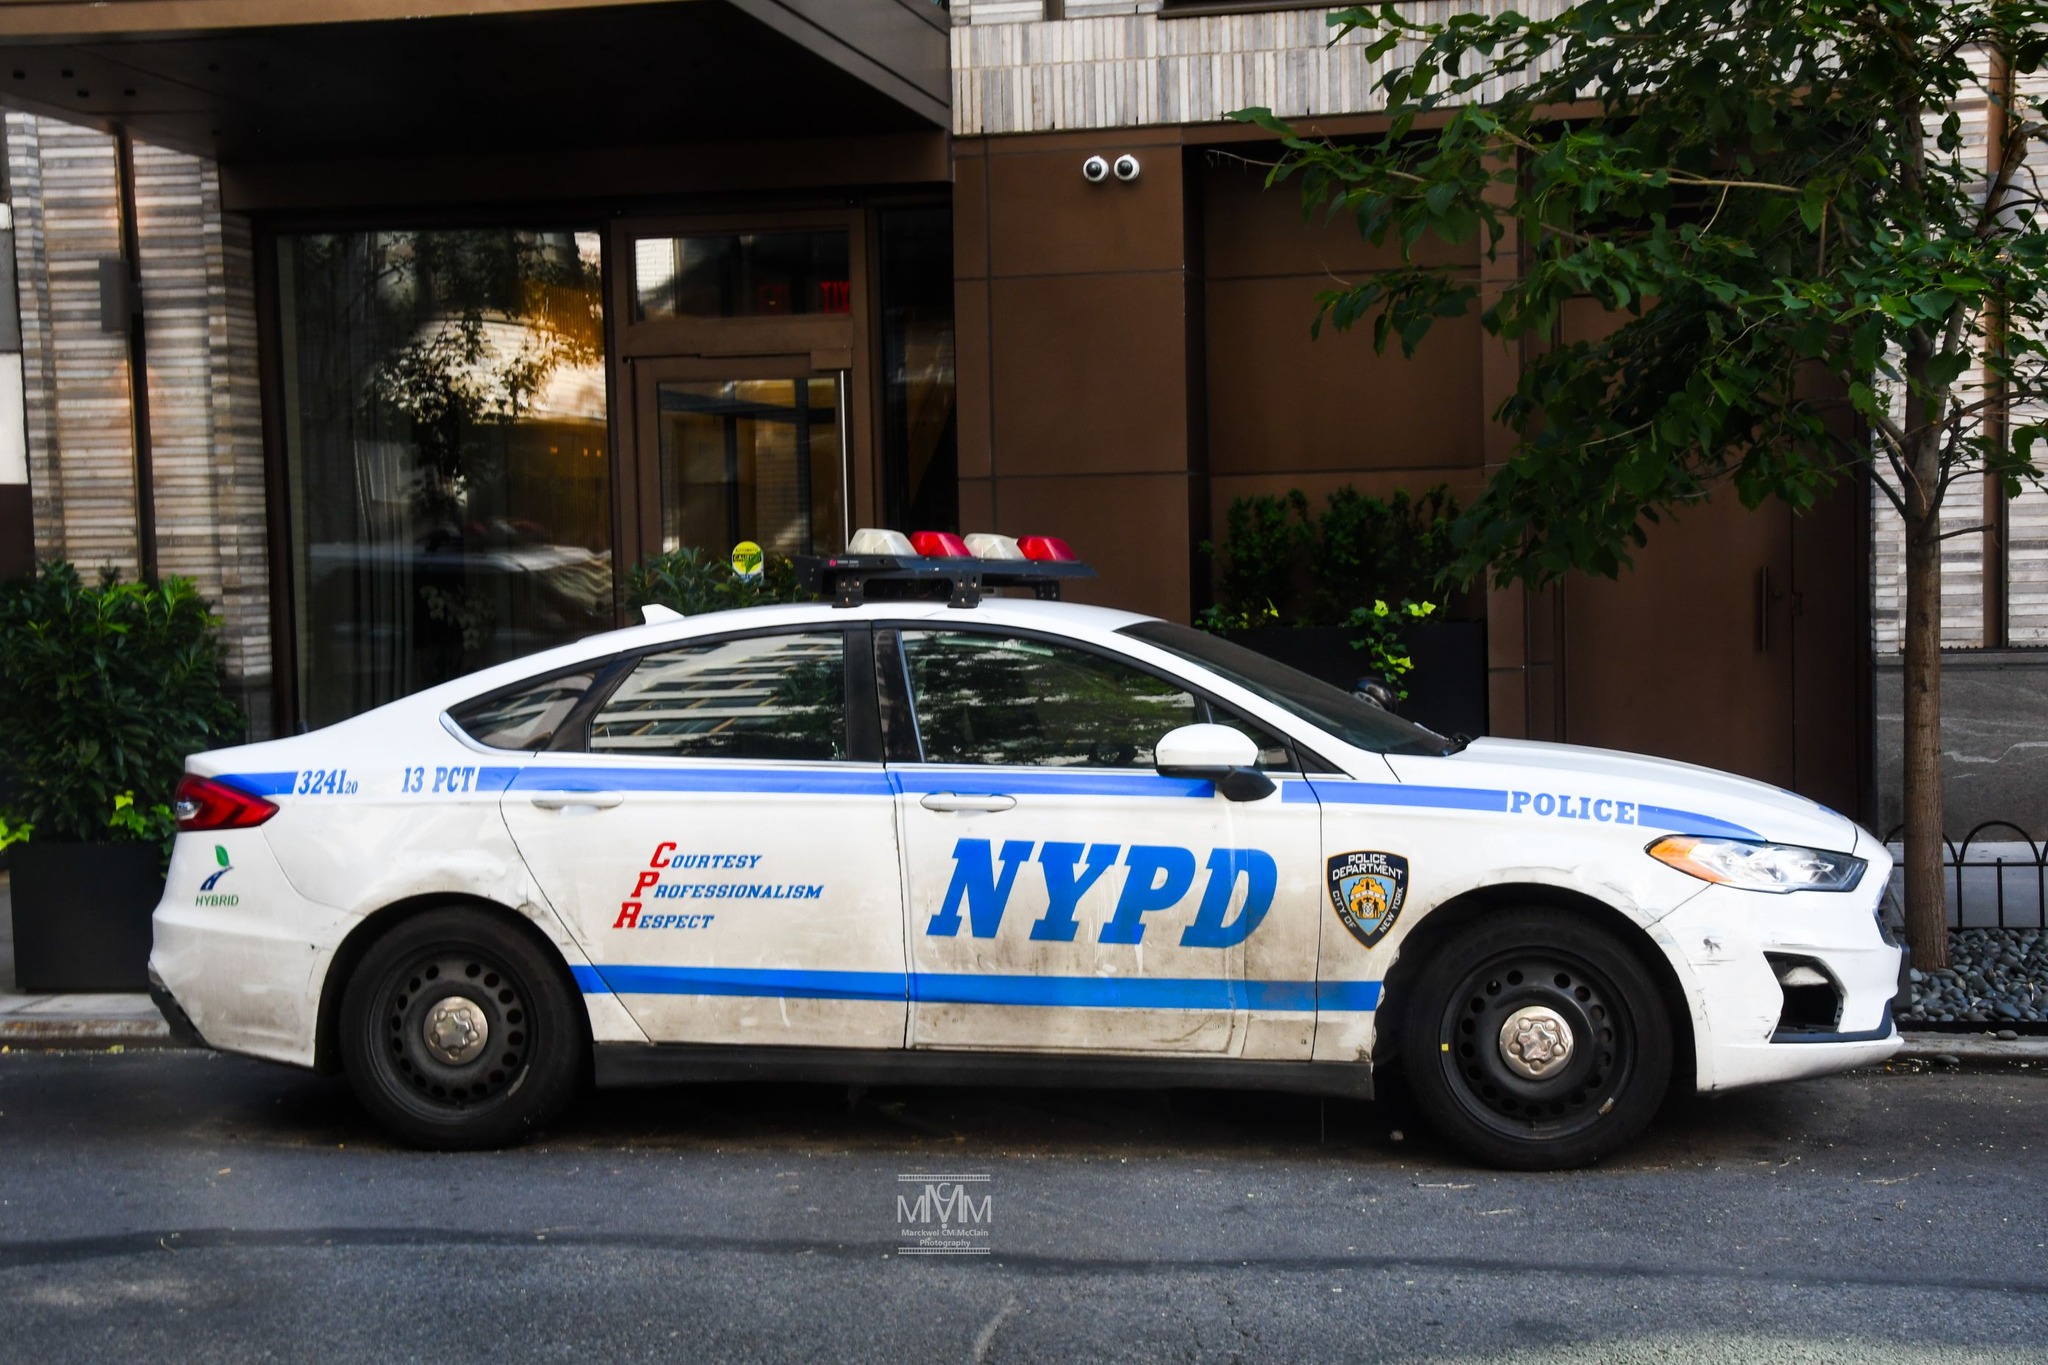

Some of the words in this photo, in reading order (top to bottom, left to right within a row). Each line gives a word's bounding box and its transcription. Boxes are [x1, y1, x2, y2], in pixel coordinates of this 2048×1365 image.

[298, 769, 347, 795] 3241
[402, 767, 423, 793] 13
[432, 767, 475, 793] PCT
[1510, 791, 1635, 825] POLICE
[1332, 863, 1403, 881] DEPARTMENT
[1348, 853, 1387, 865] POLICE
[195, 895, 239, 907] HYBRID
[926, 838, 1278, 949] NYPD
[1332, 890, 1347, 914] CITY
[1343, 915, 1357, 929] OF
[1379, 911, 1395, 933] NEW
[1391, 886, 1404, 911] YORK
